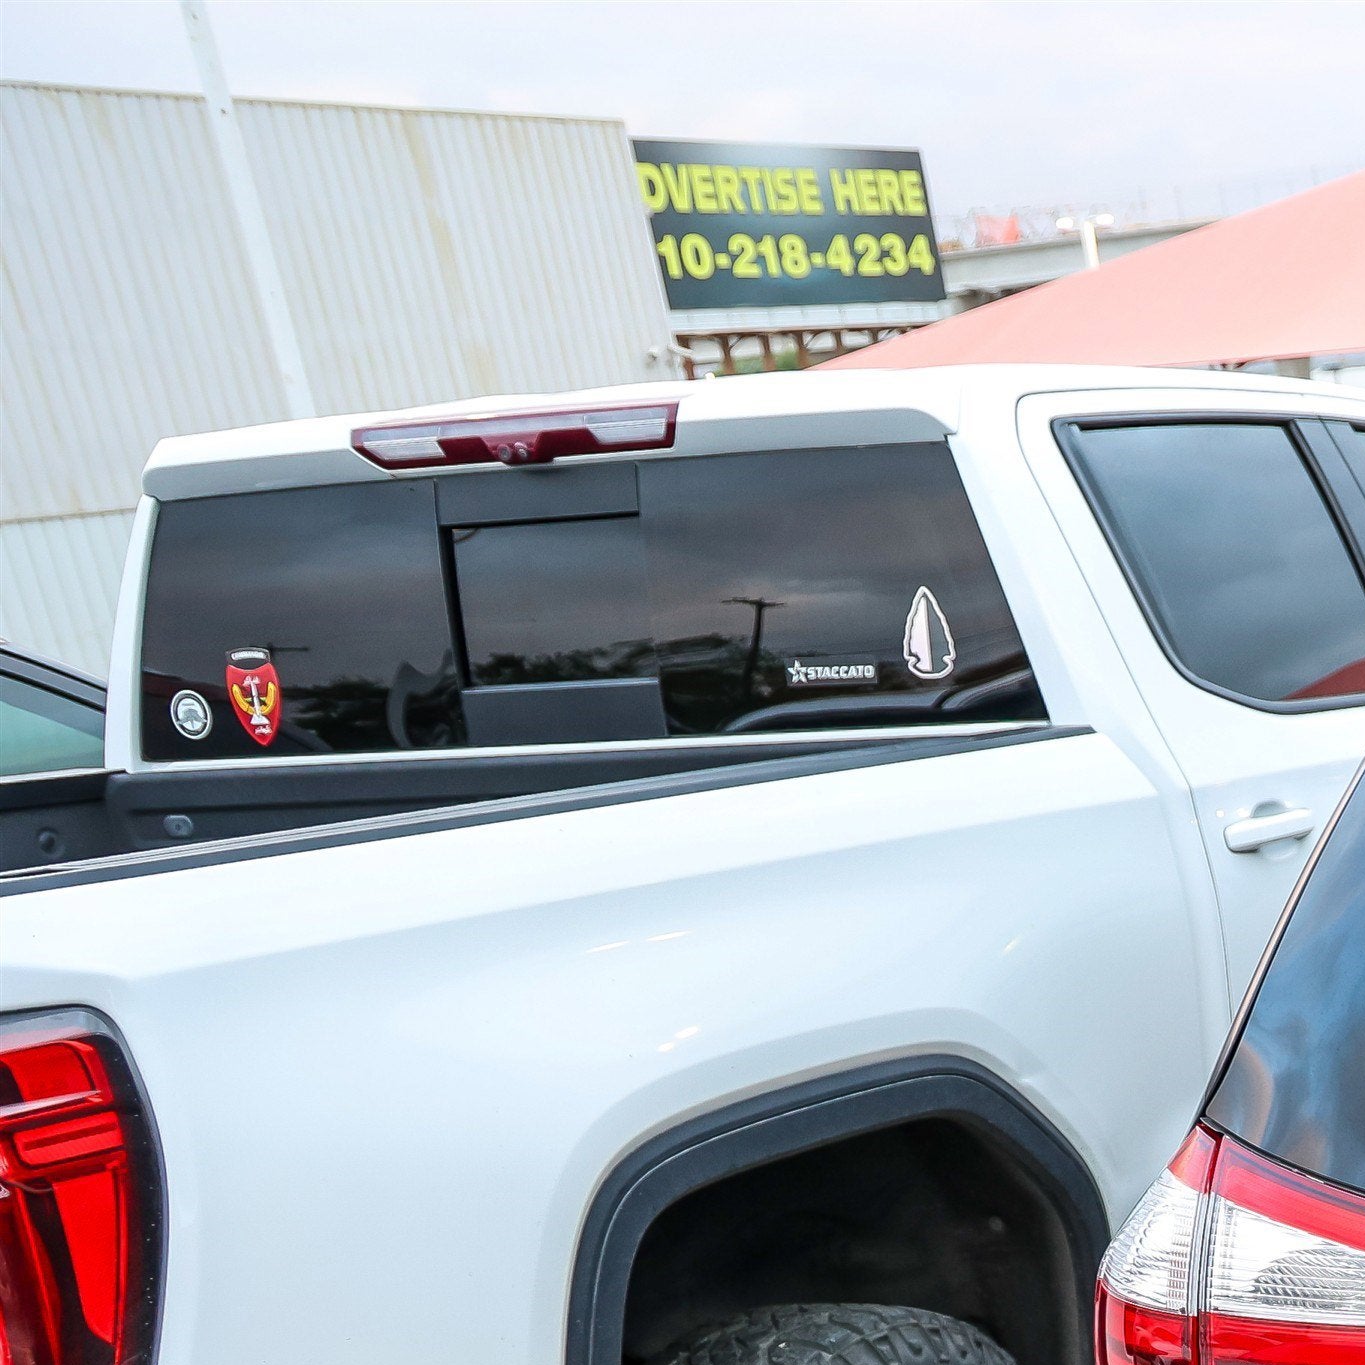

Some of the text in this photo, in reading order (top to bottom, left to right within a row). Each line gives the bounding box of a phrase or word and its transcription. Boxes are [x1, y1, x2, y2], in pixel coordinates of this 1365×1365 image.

[829, 168, 928, 216] HERE
[656, 232, 935, 280] 10-218-4234
[807, 664, 876, 680] STACCATO
